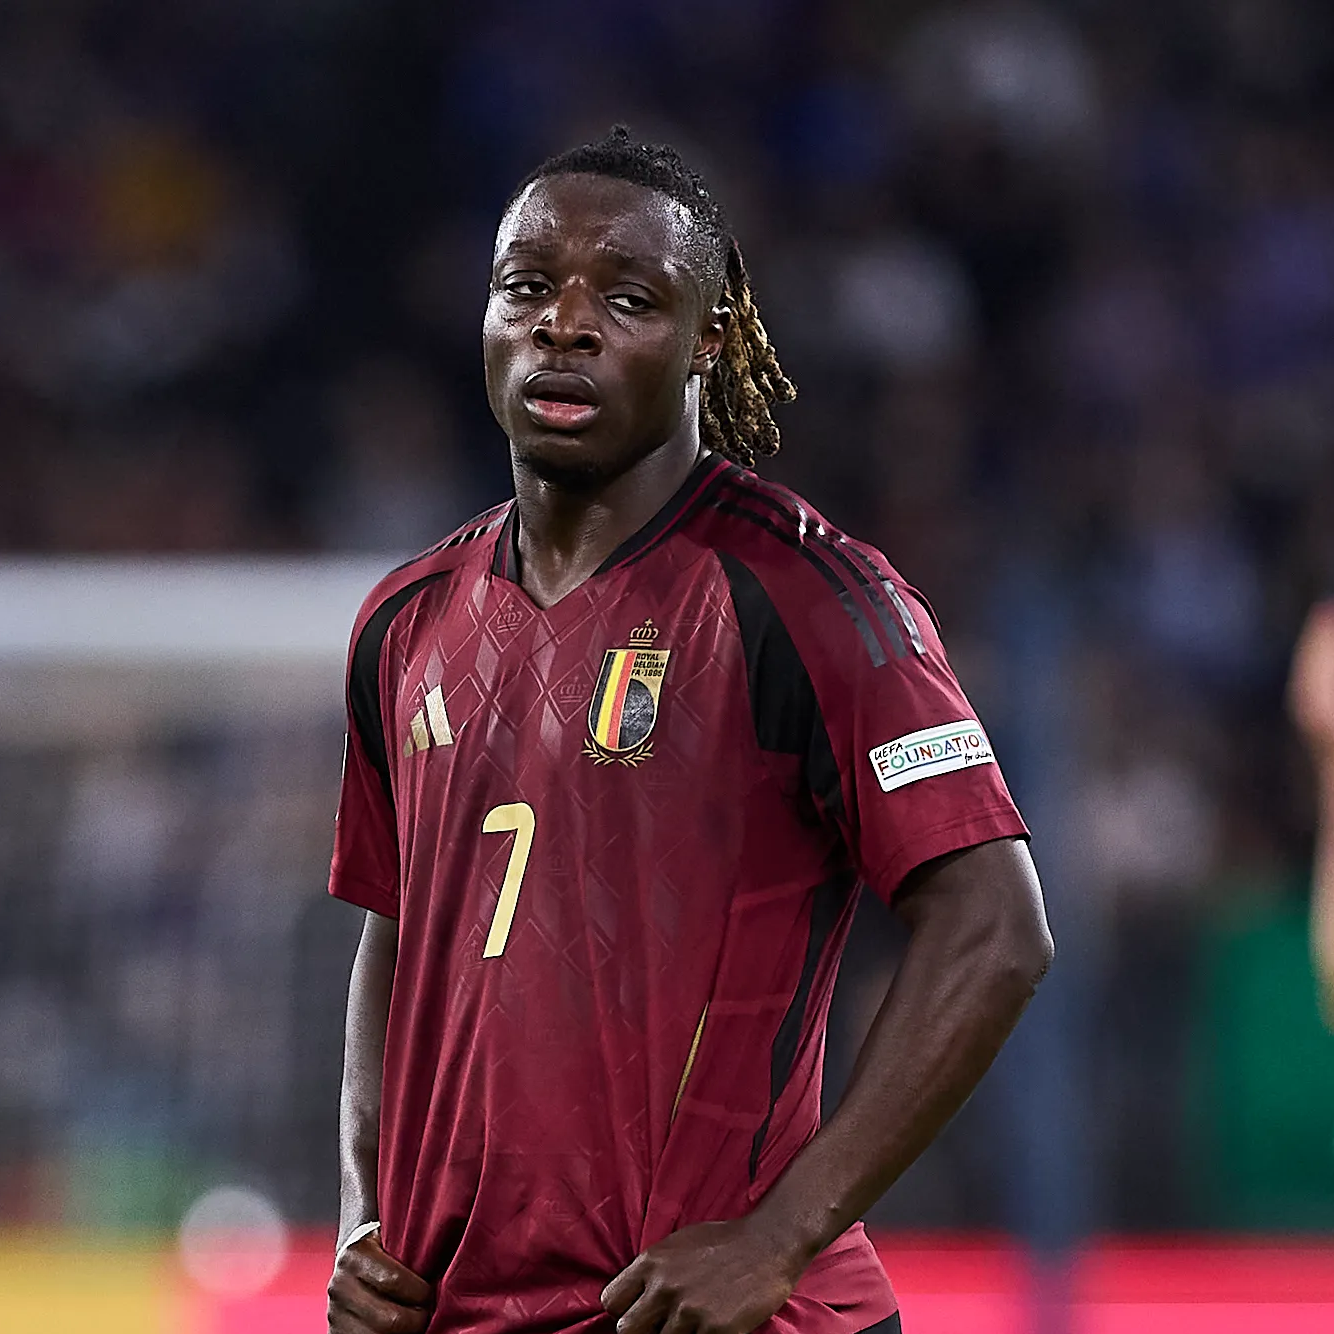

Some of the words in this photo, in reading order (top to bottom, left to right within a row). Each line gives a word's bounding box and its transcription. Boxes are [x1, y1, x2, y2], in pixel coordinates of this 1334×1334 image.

[635, 653, 660, 661] ROYAL
[873, 742, 905, 761] UEFA
[482, 802, 536, 959] 7
